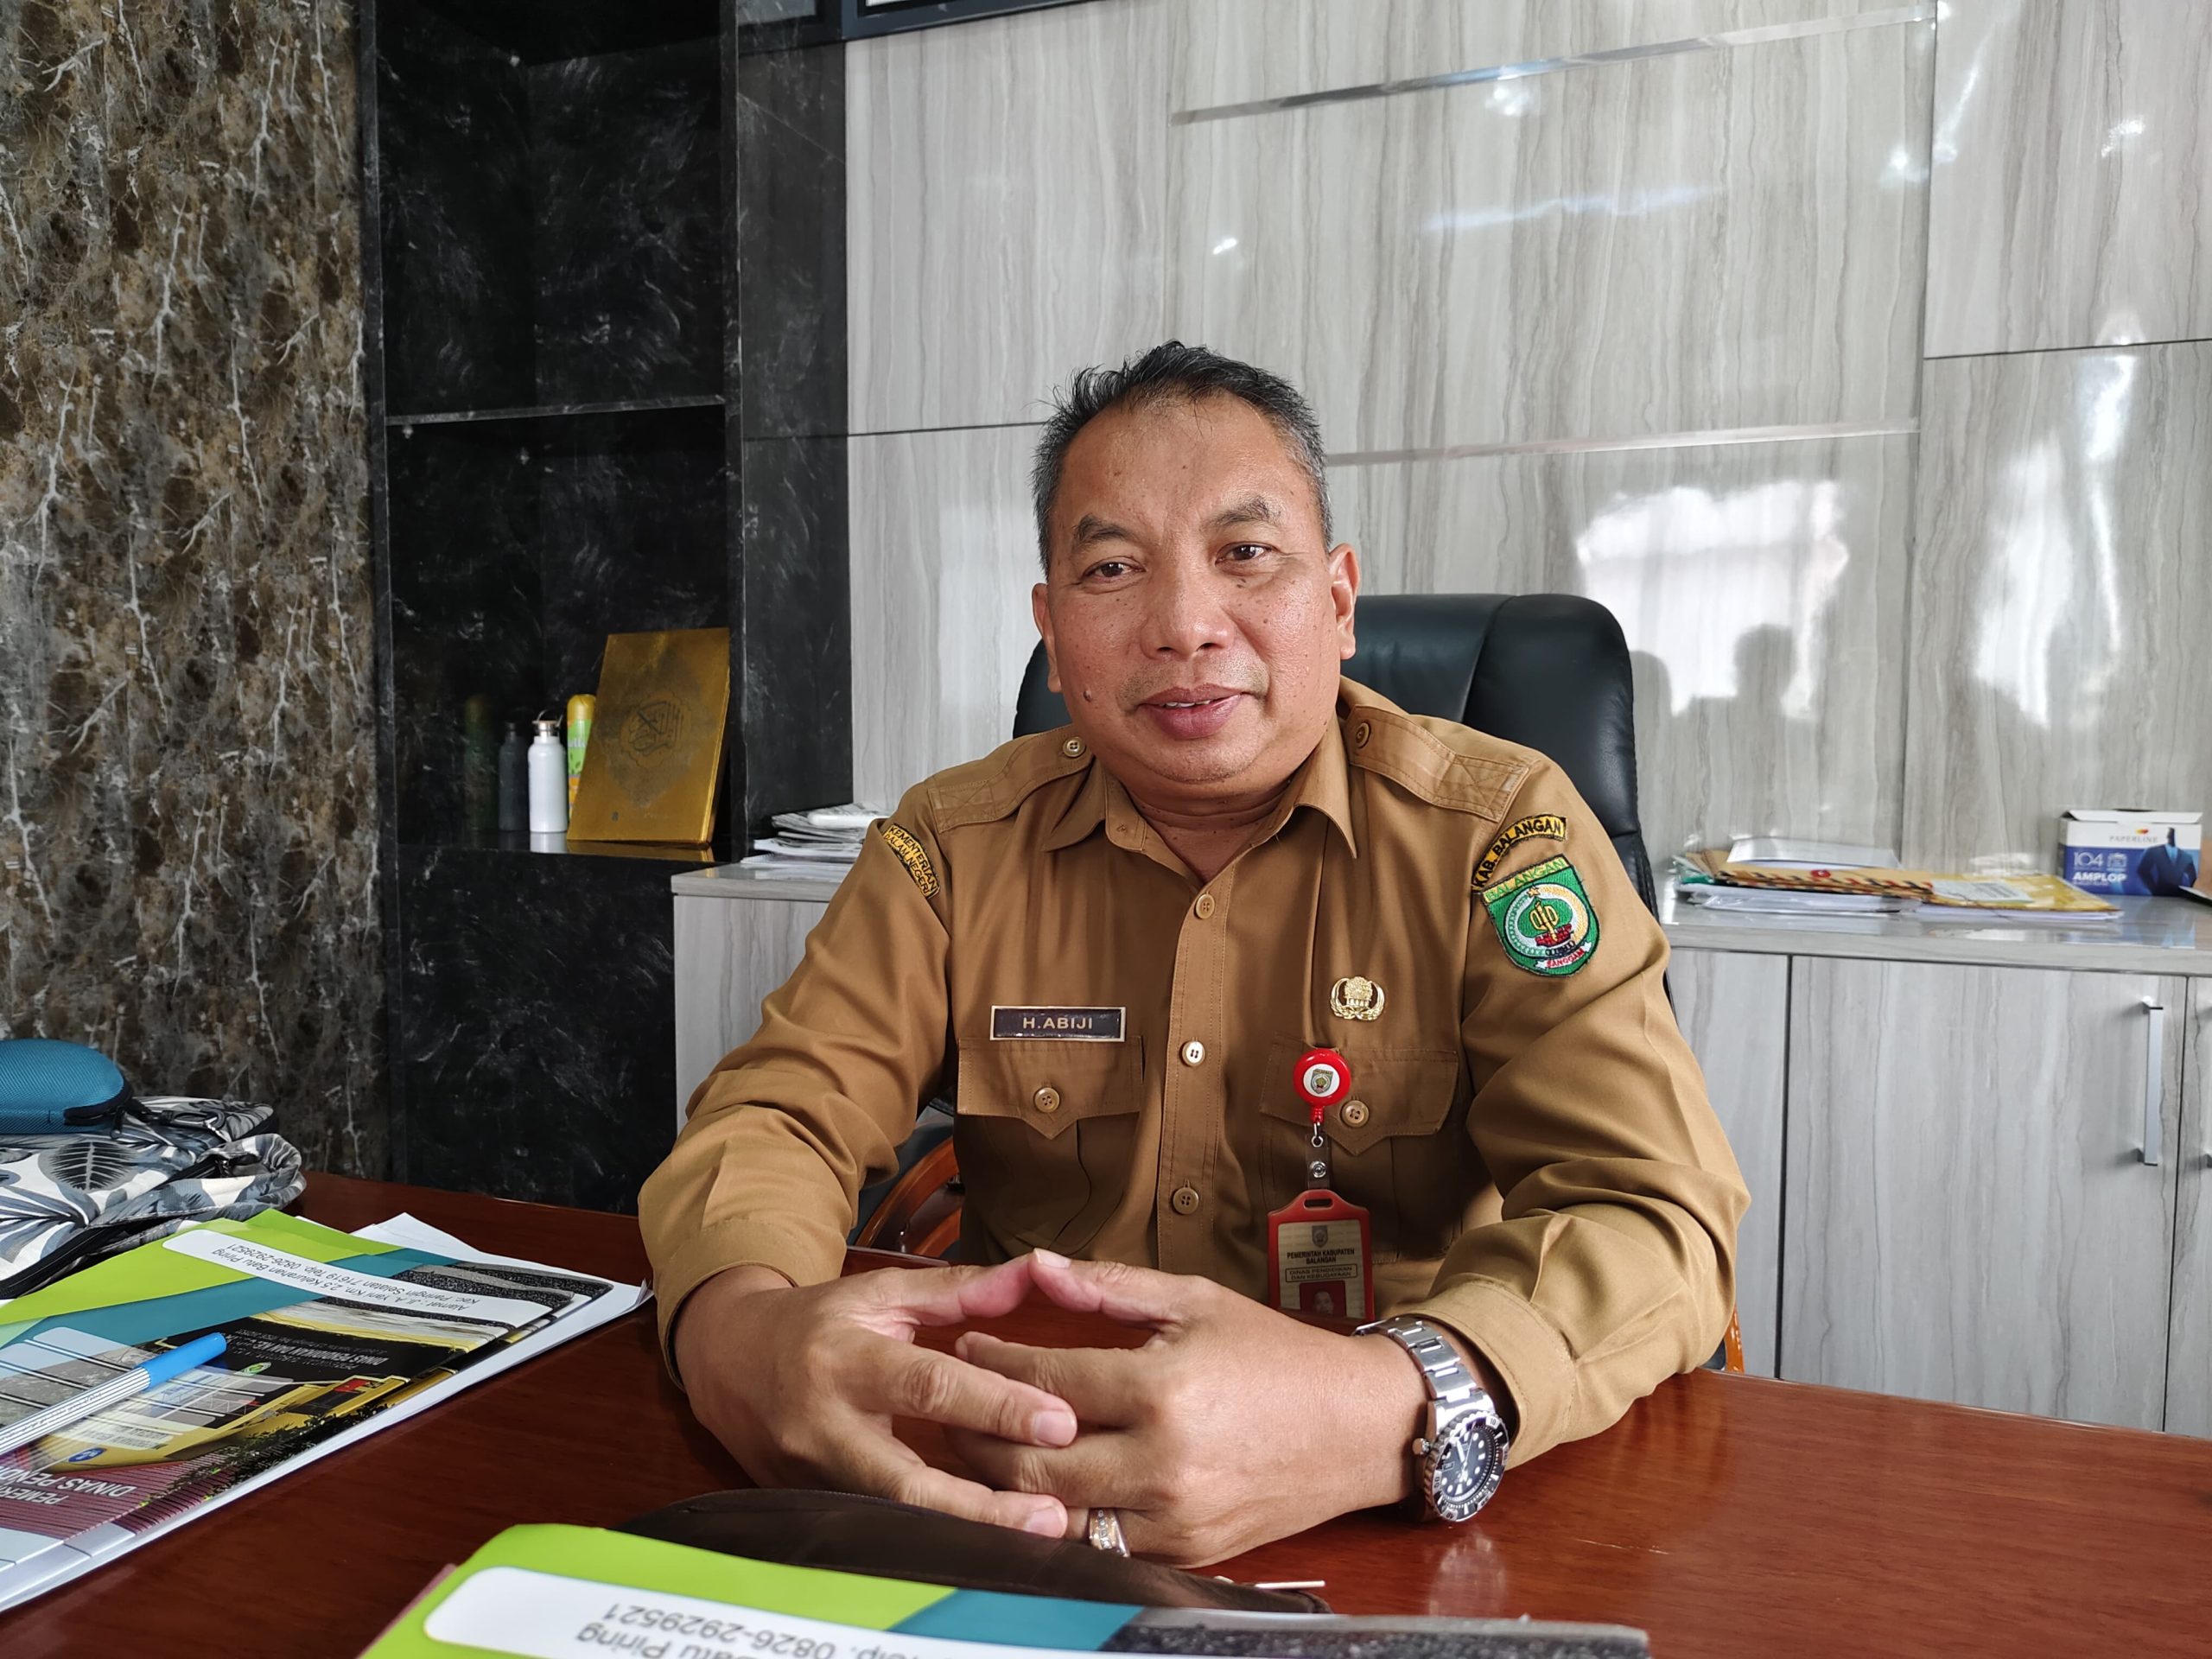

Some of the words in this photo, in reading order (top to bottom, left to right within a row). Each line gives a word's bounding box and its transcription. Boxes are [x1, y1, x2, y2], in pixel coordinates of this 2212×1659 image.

[889, 827, 938, 891] KEMENTERIAN
[1472, 856, 1497, 887] KAB.
[1492, 818, 1562, 856] BALANGAN
[2074, 852, 2104, 867] 104
[906, 857, 931, 893] NEGERI
[1484, 858, 1567, 900] BALANGAN
[2072, 871, 2126, 881] AMPLOP
[1022, 1017, 1093, 1029] H.ABIJI
[213, 1249, 242, 1263] Piring
[226, 1243, 302, 1269] 0826-2929521
[1287, 1250, 1322, 1259] PEMERINTAH
[243, 1258, 267, 1271] Batu
[304, 1265, 327, 1275] Telp.
[269, 1267, 322, 1286] Kelurahan
[326, 1272, 361, 1286] 71619
[345, 1286, 366, 1296] Km.
[363, 1281, 405, 1295] Selatan
[366, 1291, 390, 1300] Yani
[428, 1301, 470, 1311] Alamat
[57, 1478, 137, 1497] DINAS
[602, 1602, 837, 1659] 0826-2929521
[576, 1621, 672, 1659] Piring
